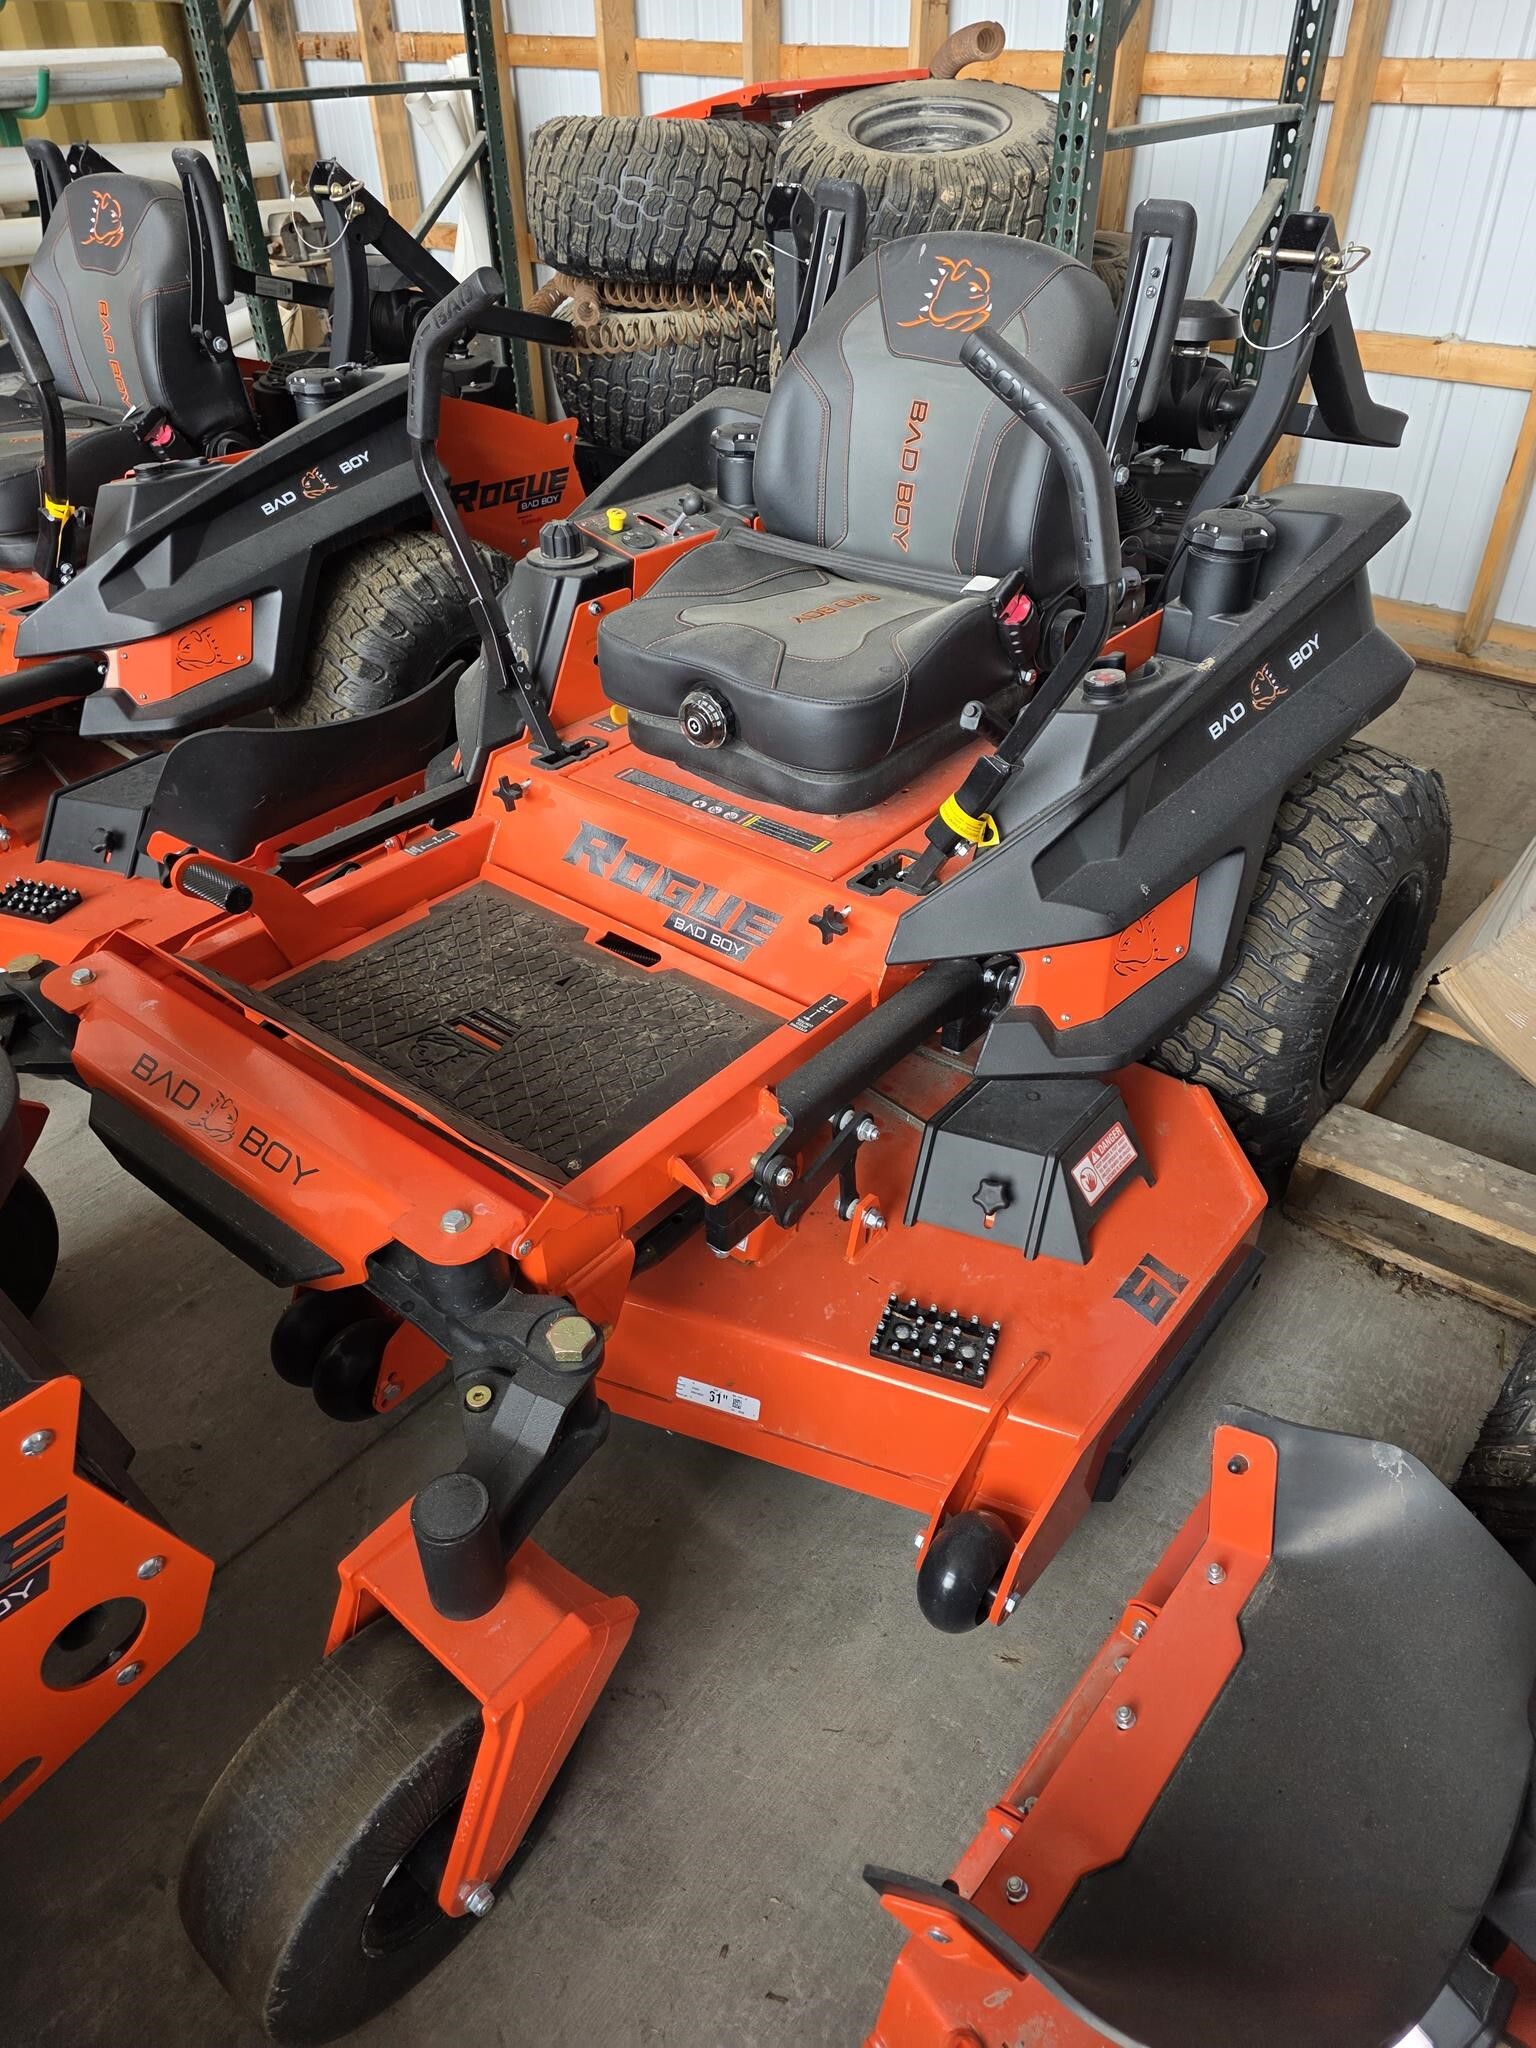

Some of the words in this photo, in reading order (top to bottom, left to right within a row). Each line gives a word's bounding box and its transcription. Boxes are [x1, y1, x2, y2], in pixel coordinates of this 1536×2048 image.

[98, 299, 116, 353] BAD
[108, 359, 134, 409] BOY
[969, 347, 1047, 416] BOY
[901, 399, 929, 472] BAD
[261, 491, 297, 515] BAD
[339, 450, 370, 474] BOY
[450, 467, 569, 512] ROGUE
[521, 499, 540, 510] BAD
[541, 494, 560, 505] BOY
[892, 481, 916, 553] BOY
[1208, 702, 1246, 740] BAD
[1288, 632, 1320, 670] BOY
[562, 820, 784, 947] ROGUE
[672, 916, 707, 941] BAD
[709, 934, 745, 956] BOY
[130, 1053, 200, 1111] BAD
[238, 1125, 320, 1186] BOY
[1097, 1126, 1123, 1155] DANGER
[1112, 1253, 1190, 1327] 61
